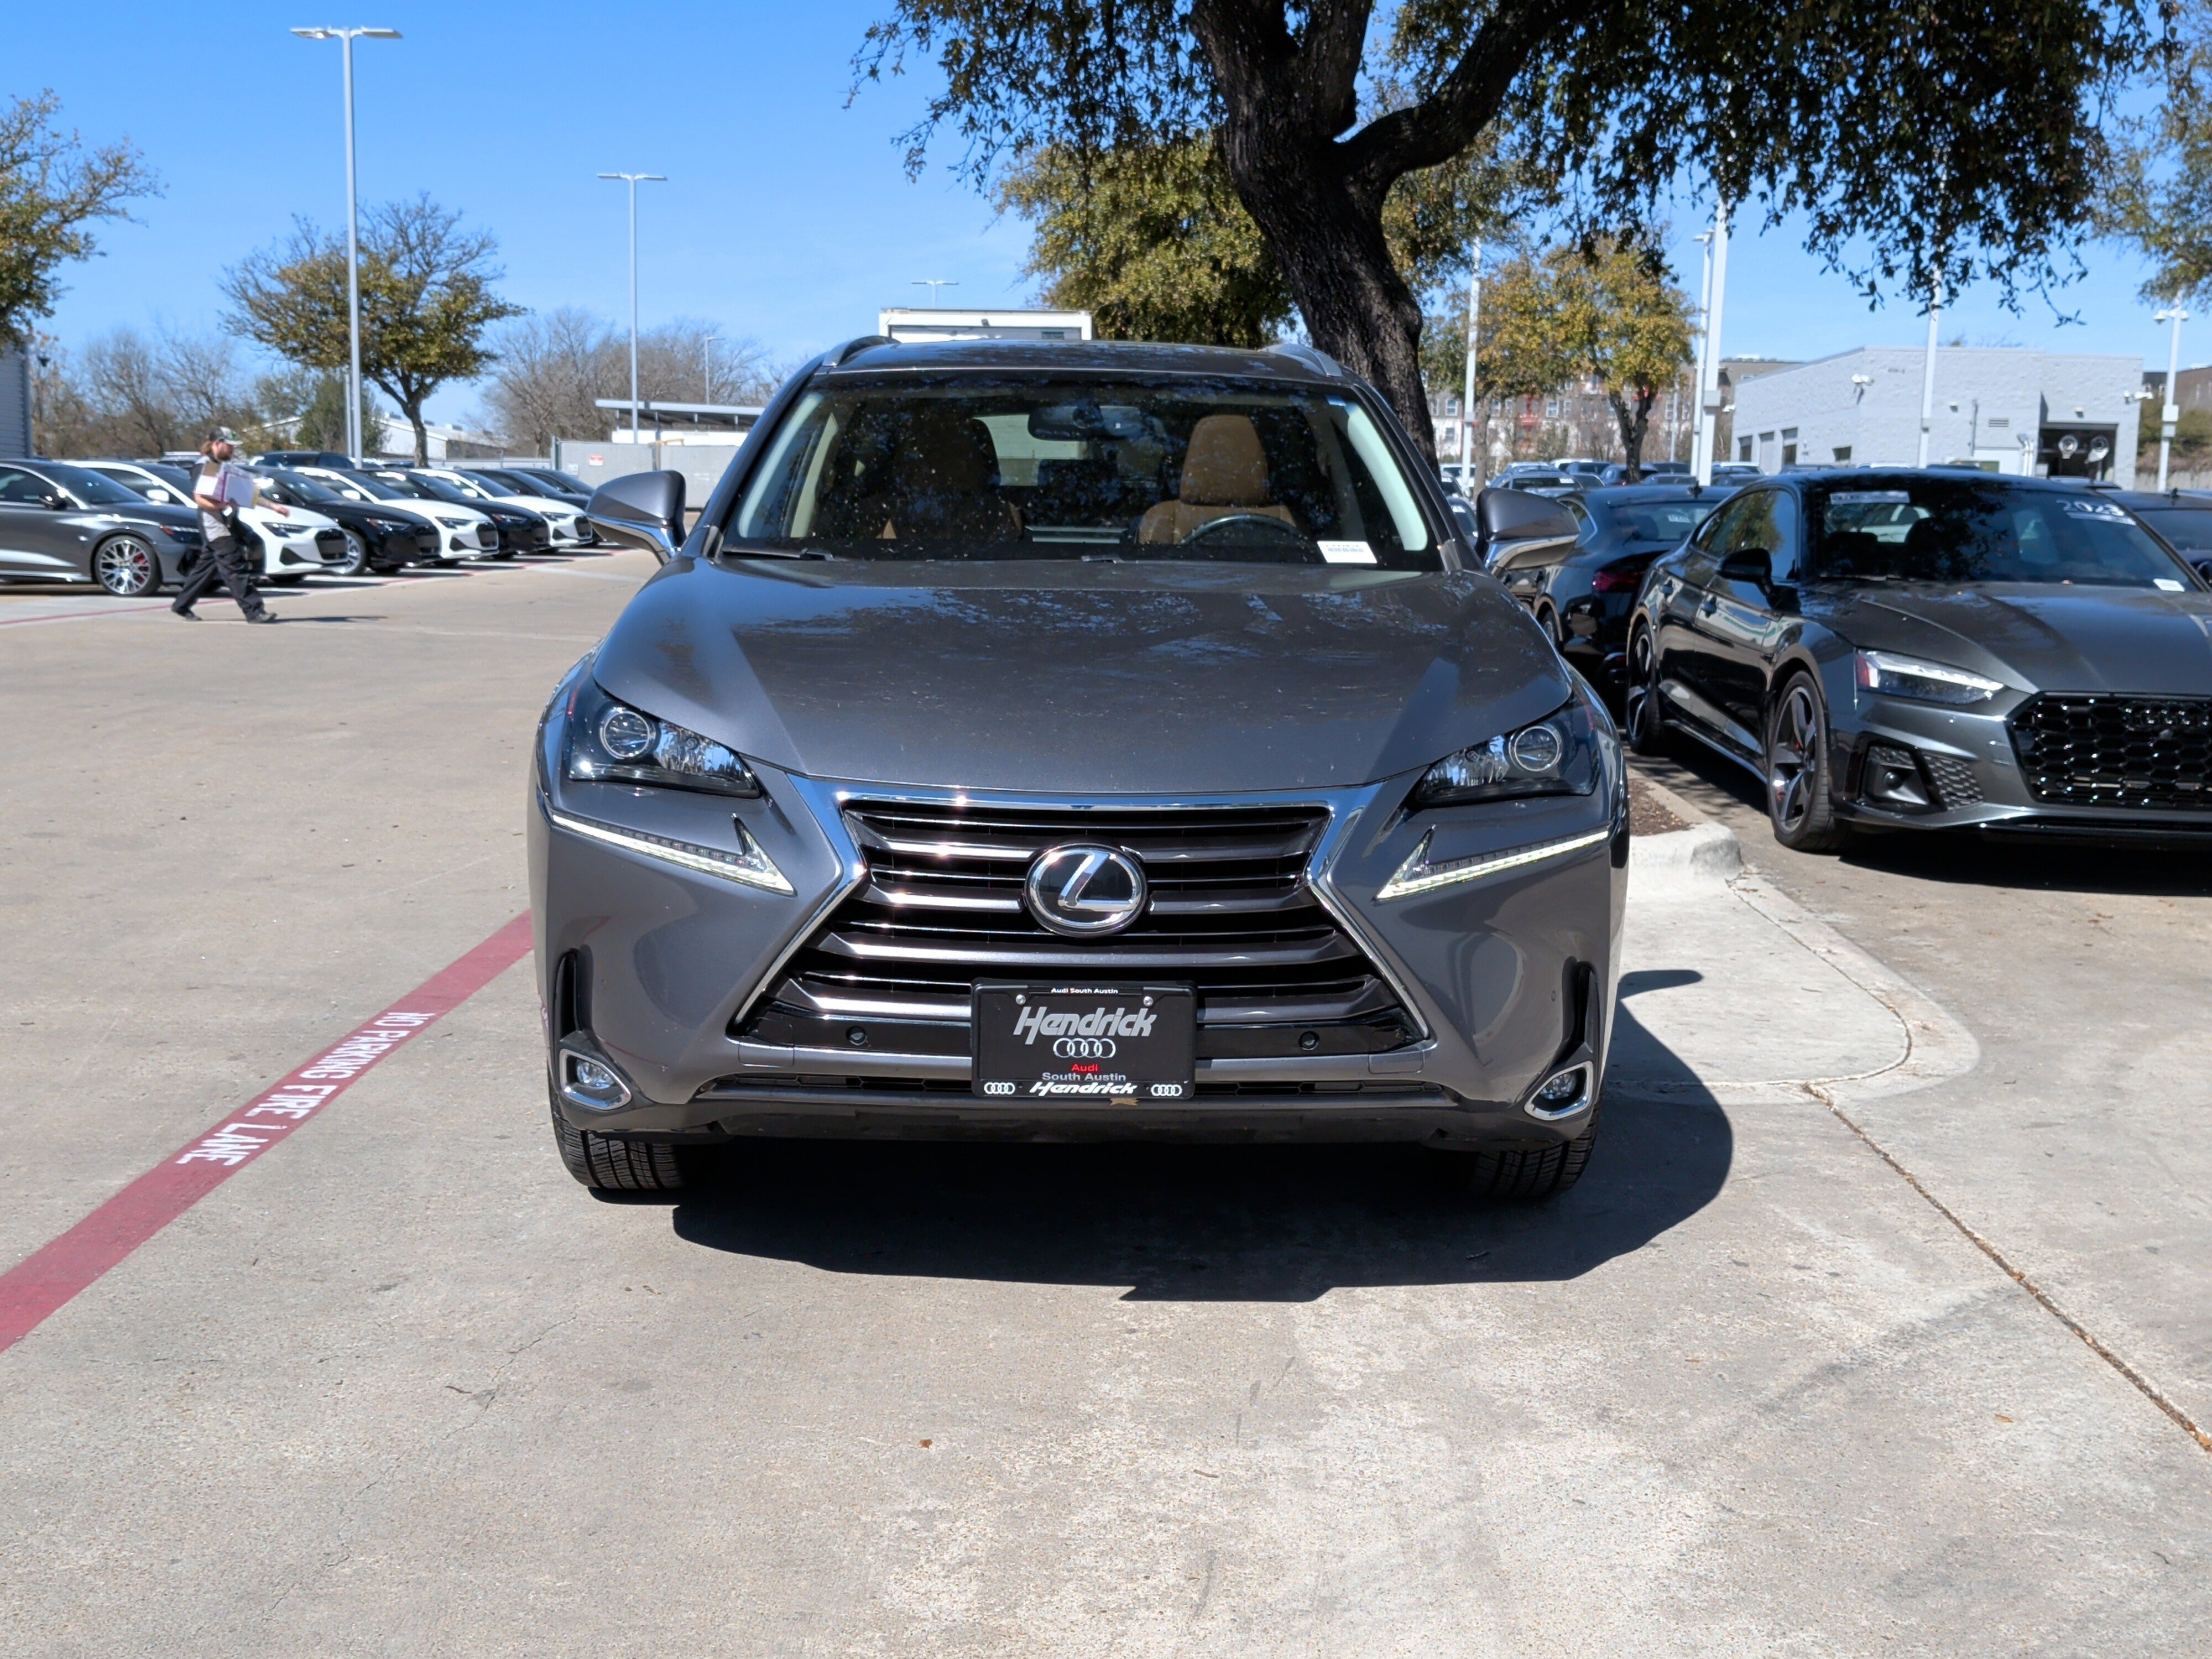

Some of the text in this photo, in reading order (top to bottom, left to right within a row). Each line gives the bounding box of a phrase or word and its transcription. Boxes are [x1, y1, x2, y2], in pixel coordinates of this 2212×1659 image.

[1013, 1006, 1157, 1045] Hendrick
[1071, 1063, 1099, 1072] Audi
[1042, 1072, 1126, 1082] South Austin
[175, 1012, 436, 1166] NO PARKING FIRE LANE
[1029, 1082, 1138, 1097] Hendrick
